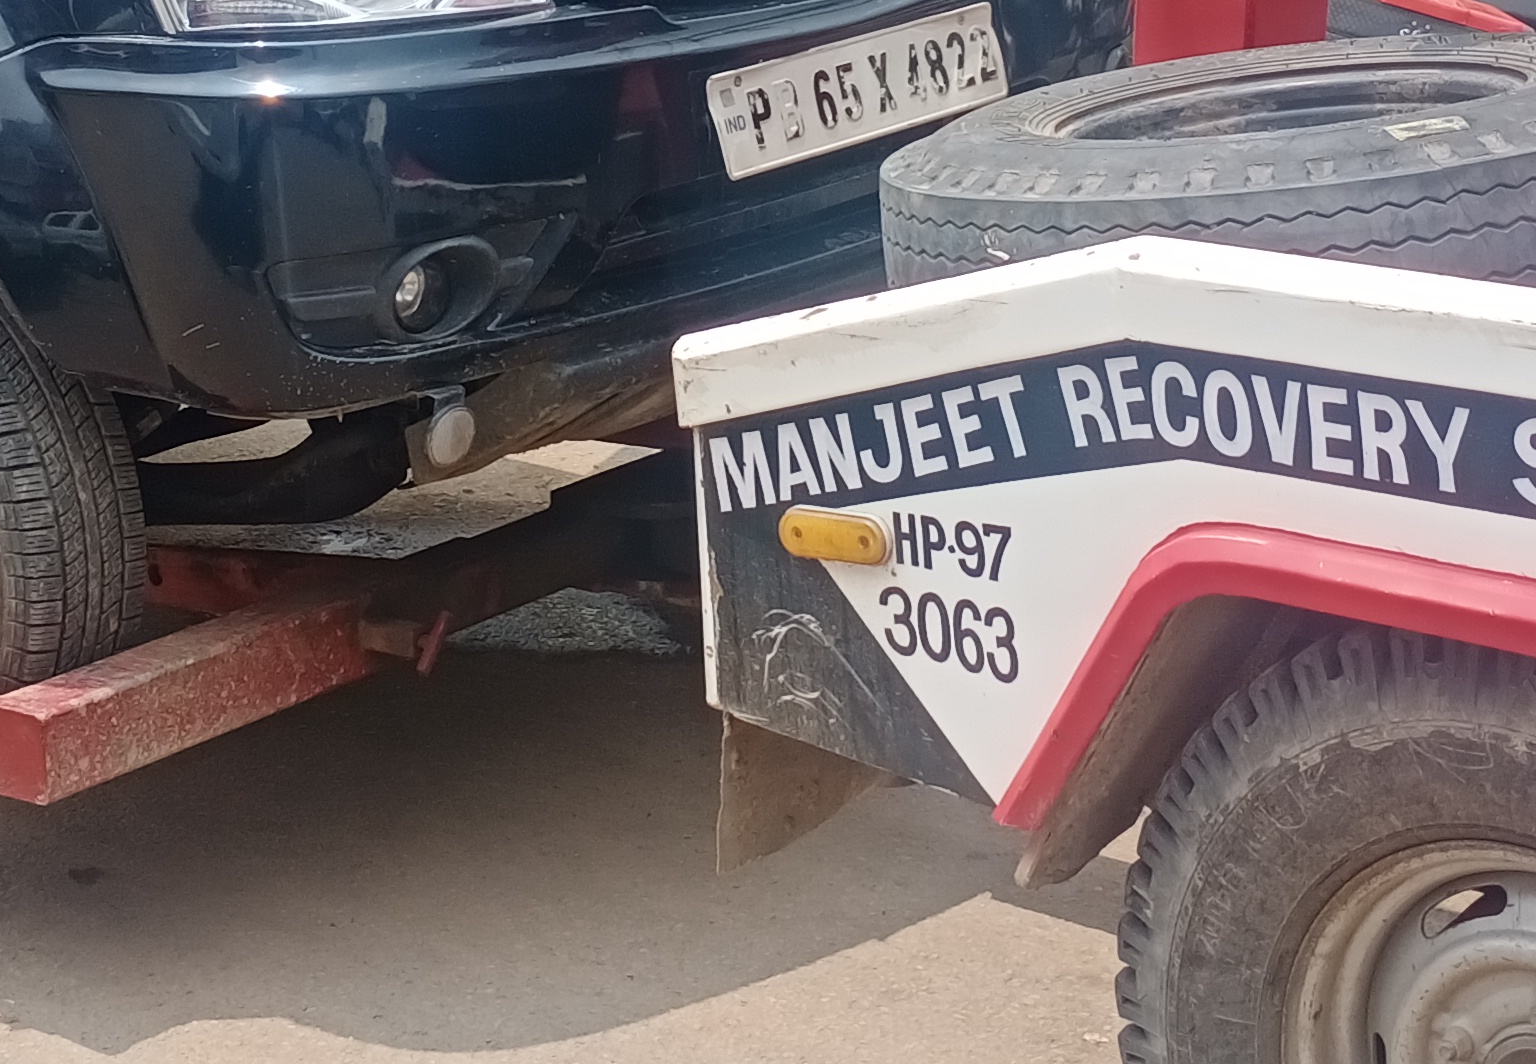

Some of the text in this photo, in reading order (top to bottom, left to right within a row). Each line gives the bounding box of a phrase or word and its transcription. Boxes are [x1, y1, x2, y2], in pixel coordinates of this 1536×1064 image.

[723, 113, 747, 136] IND
[813, 62, 863, 130] 65
[867, 51, 898, 114] X
[907, 26, 999, 104] 4822
[709, 374, 1025, 513] MANJEET
[1057, 355, 1470, 494] RECOVERY
[878, 585, 1019, 685] 3063
